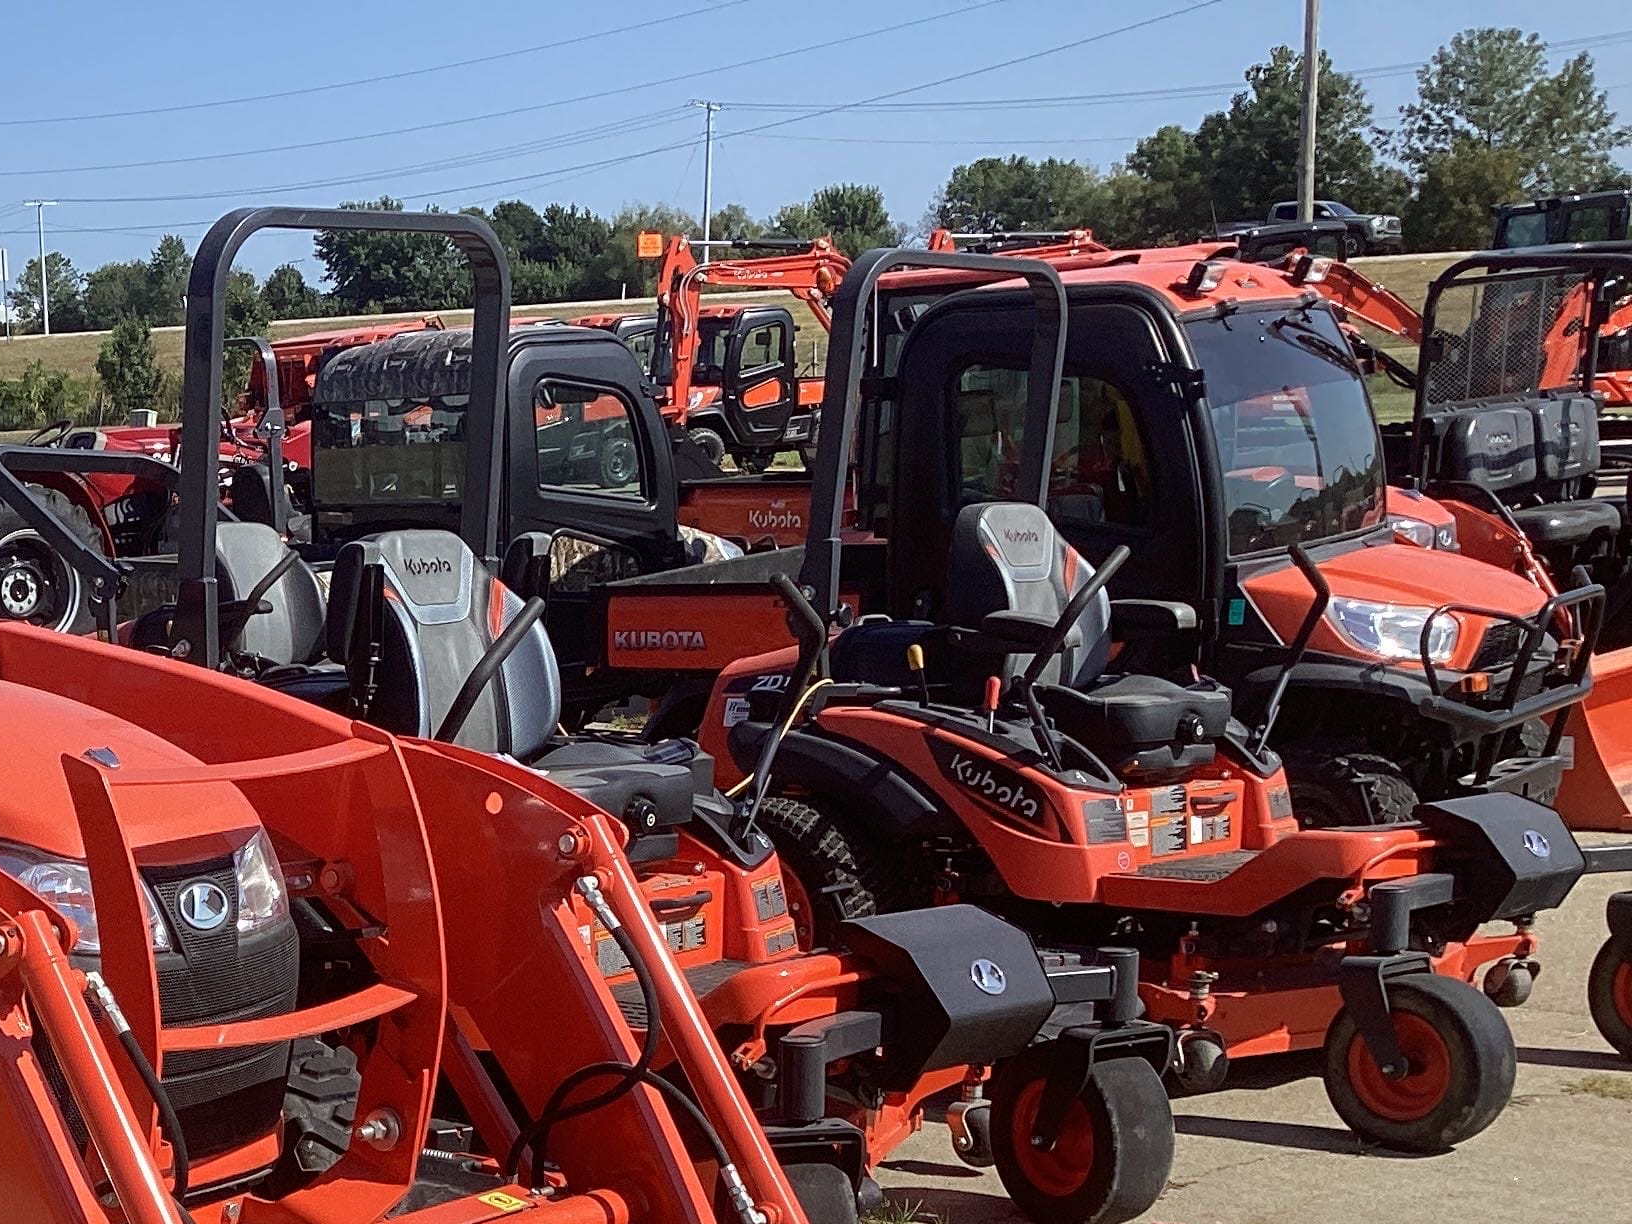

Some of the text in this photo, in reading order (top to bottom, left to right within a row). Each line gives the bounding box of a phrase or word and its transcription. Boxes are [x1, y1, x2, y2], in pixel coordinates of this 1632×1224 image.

[749, 509, 801, 529] Kubota
[403, 556, 452, 576] Kubota
[613, 630, 706, 650] KUBOTA
[950, 753, 1038, 818] Kubota
